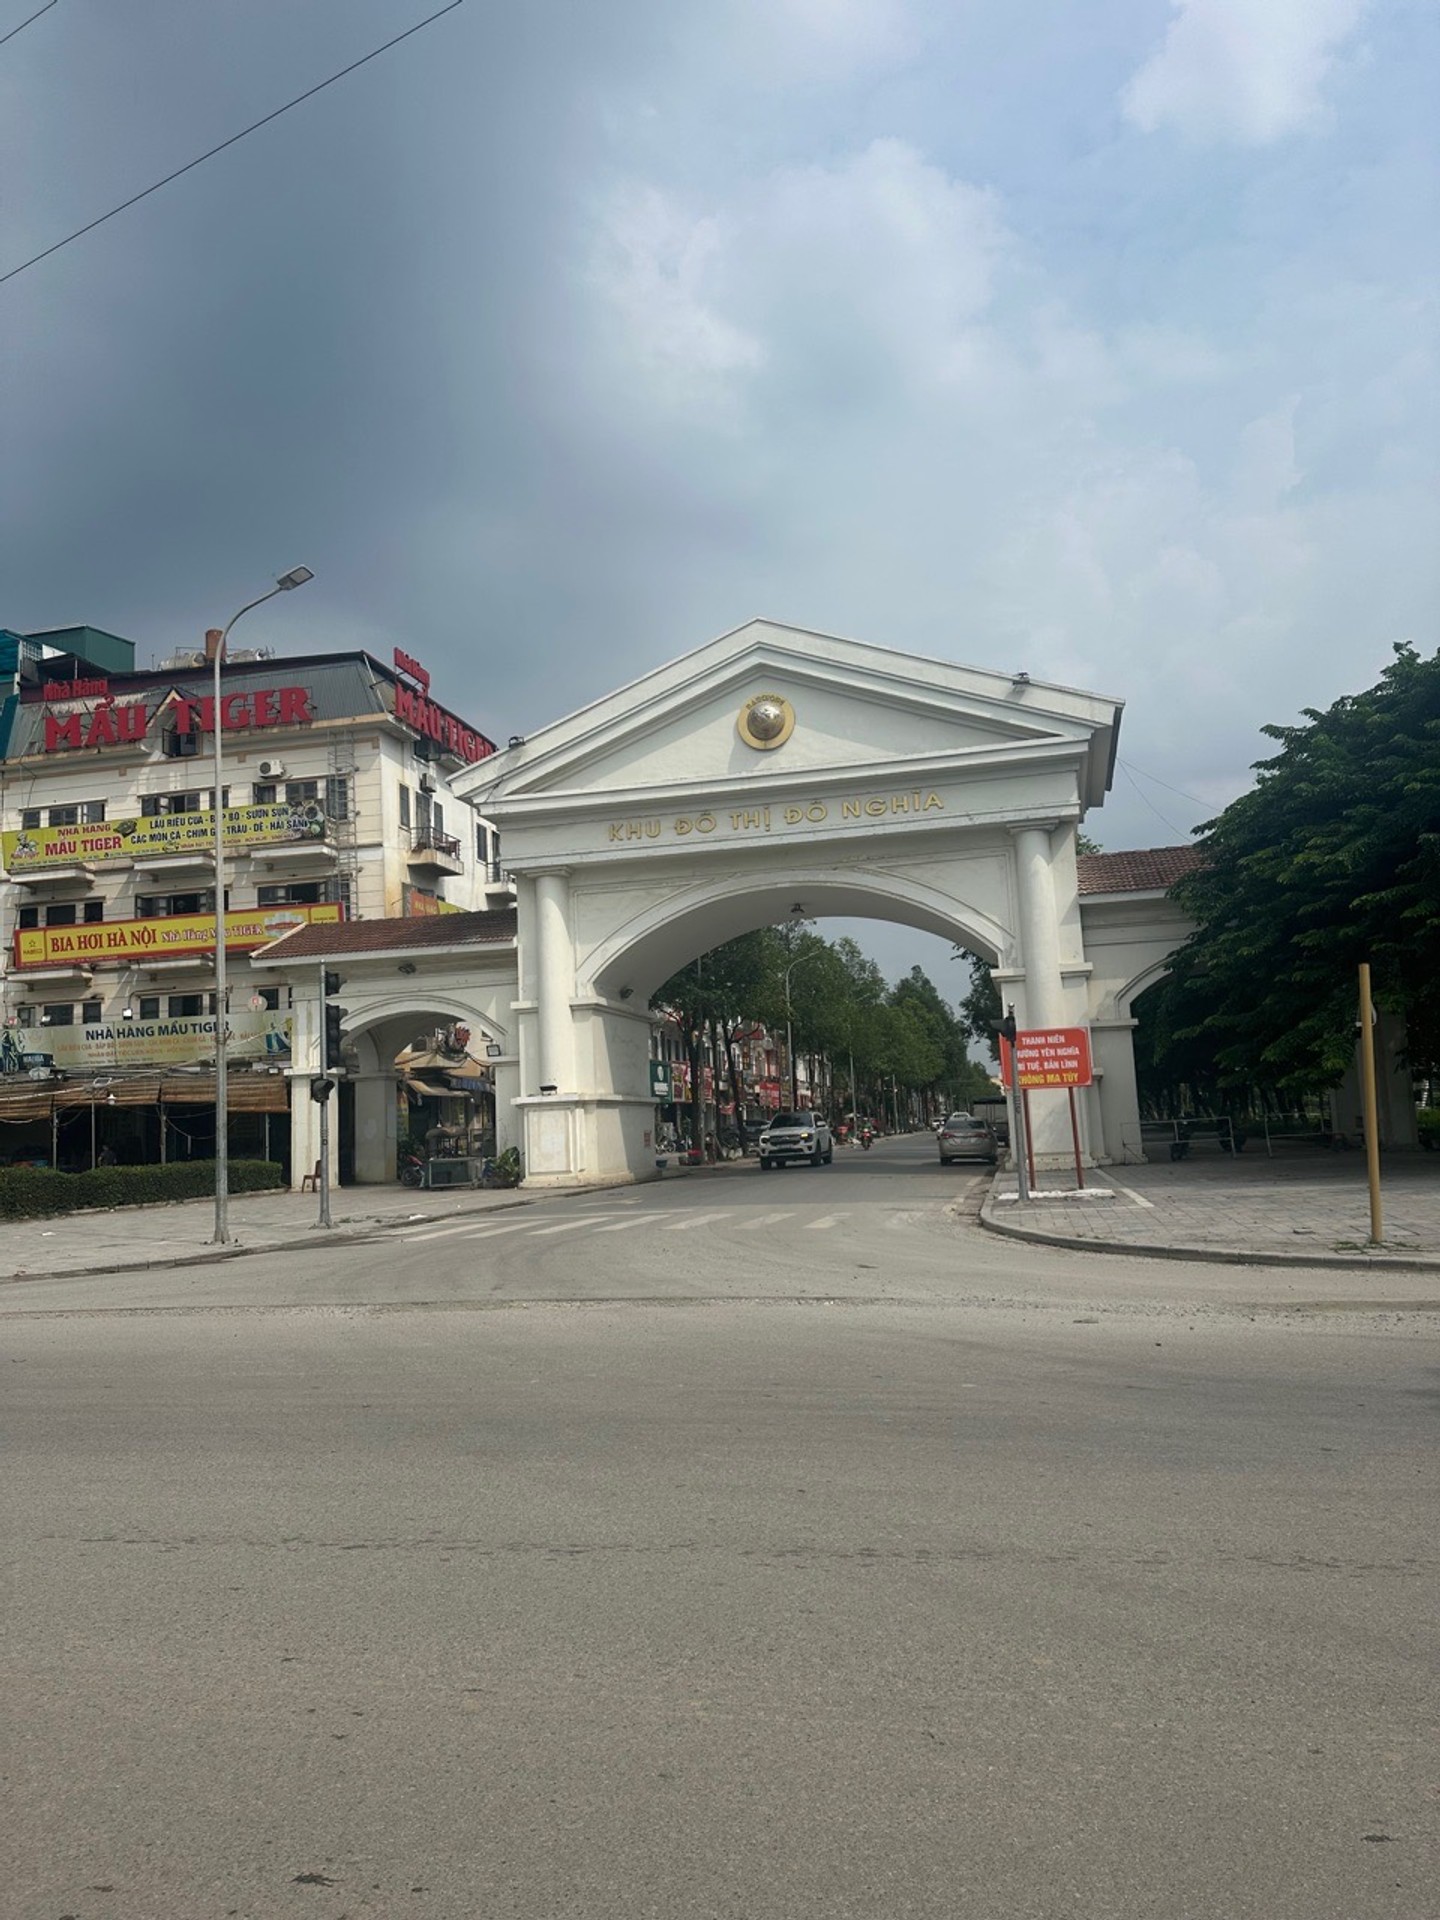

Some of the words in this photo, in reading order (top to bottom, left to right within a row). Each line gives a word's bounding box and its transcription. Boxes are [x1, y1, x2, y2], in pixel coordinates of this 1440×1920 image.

[167, 686, 313, 735] TIGER
[187, 814, 204, 826] CUA
[608, 819, 662, 842] KHU
[674, 809, 718, 836] ĐÔ
[729, 805, 771, 832] THỊ
[784, 800, 828, 825] ĐÔ
[842, 789, 944, 818] NGHĨA
[186, 828, 209, 839] CHIM
[80, 836, 123, 852] TIGER
[51, 934, 75, 952] BIA
[76, 931, 104, 950] HƠI
[106, 927, 129, 948] HÀ
[130, 925, 157, 948] NỘI
[231, 923, 264, 937] TIGER
[85, 1027, 114, 1041] NHÀ
[116, 1025, 155, 1039] HÀNG
[1021, 1036, 1046, 1046] THANH
[1047, 1034, 1066, 1044] NIÊN
[1040, 1047, 1056, 1057] YÊN
[1046, 1073, 1062, 1083] MA
